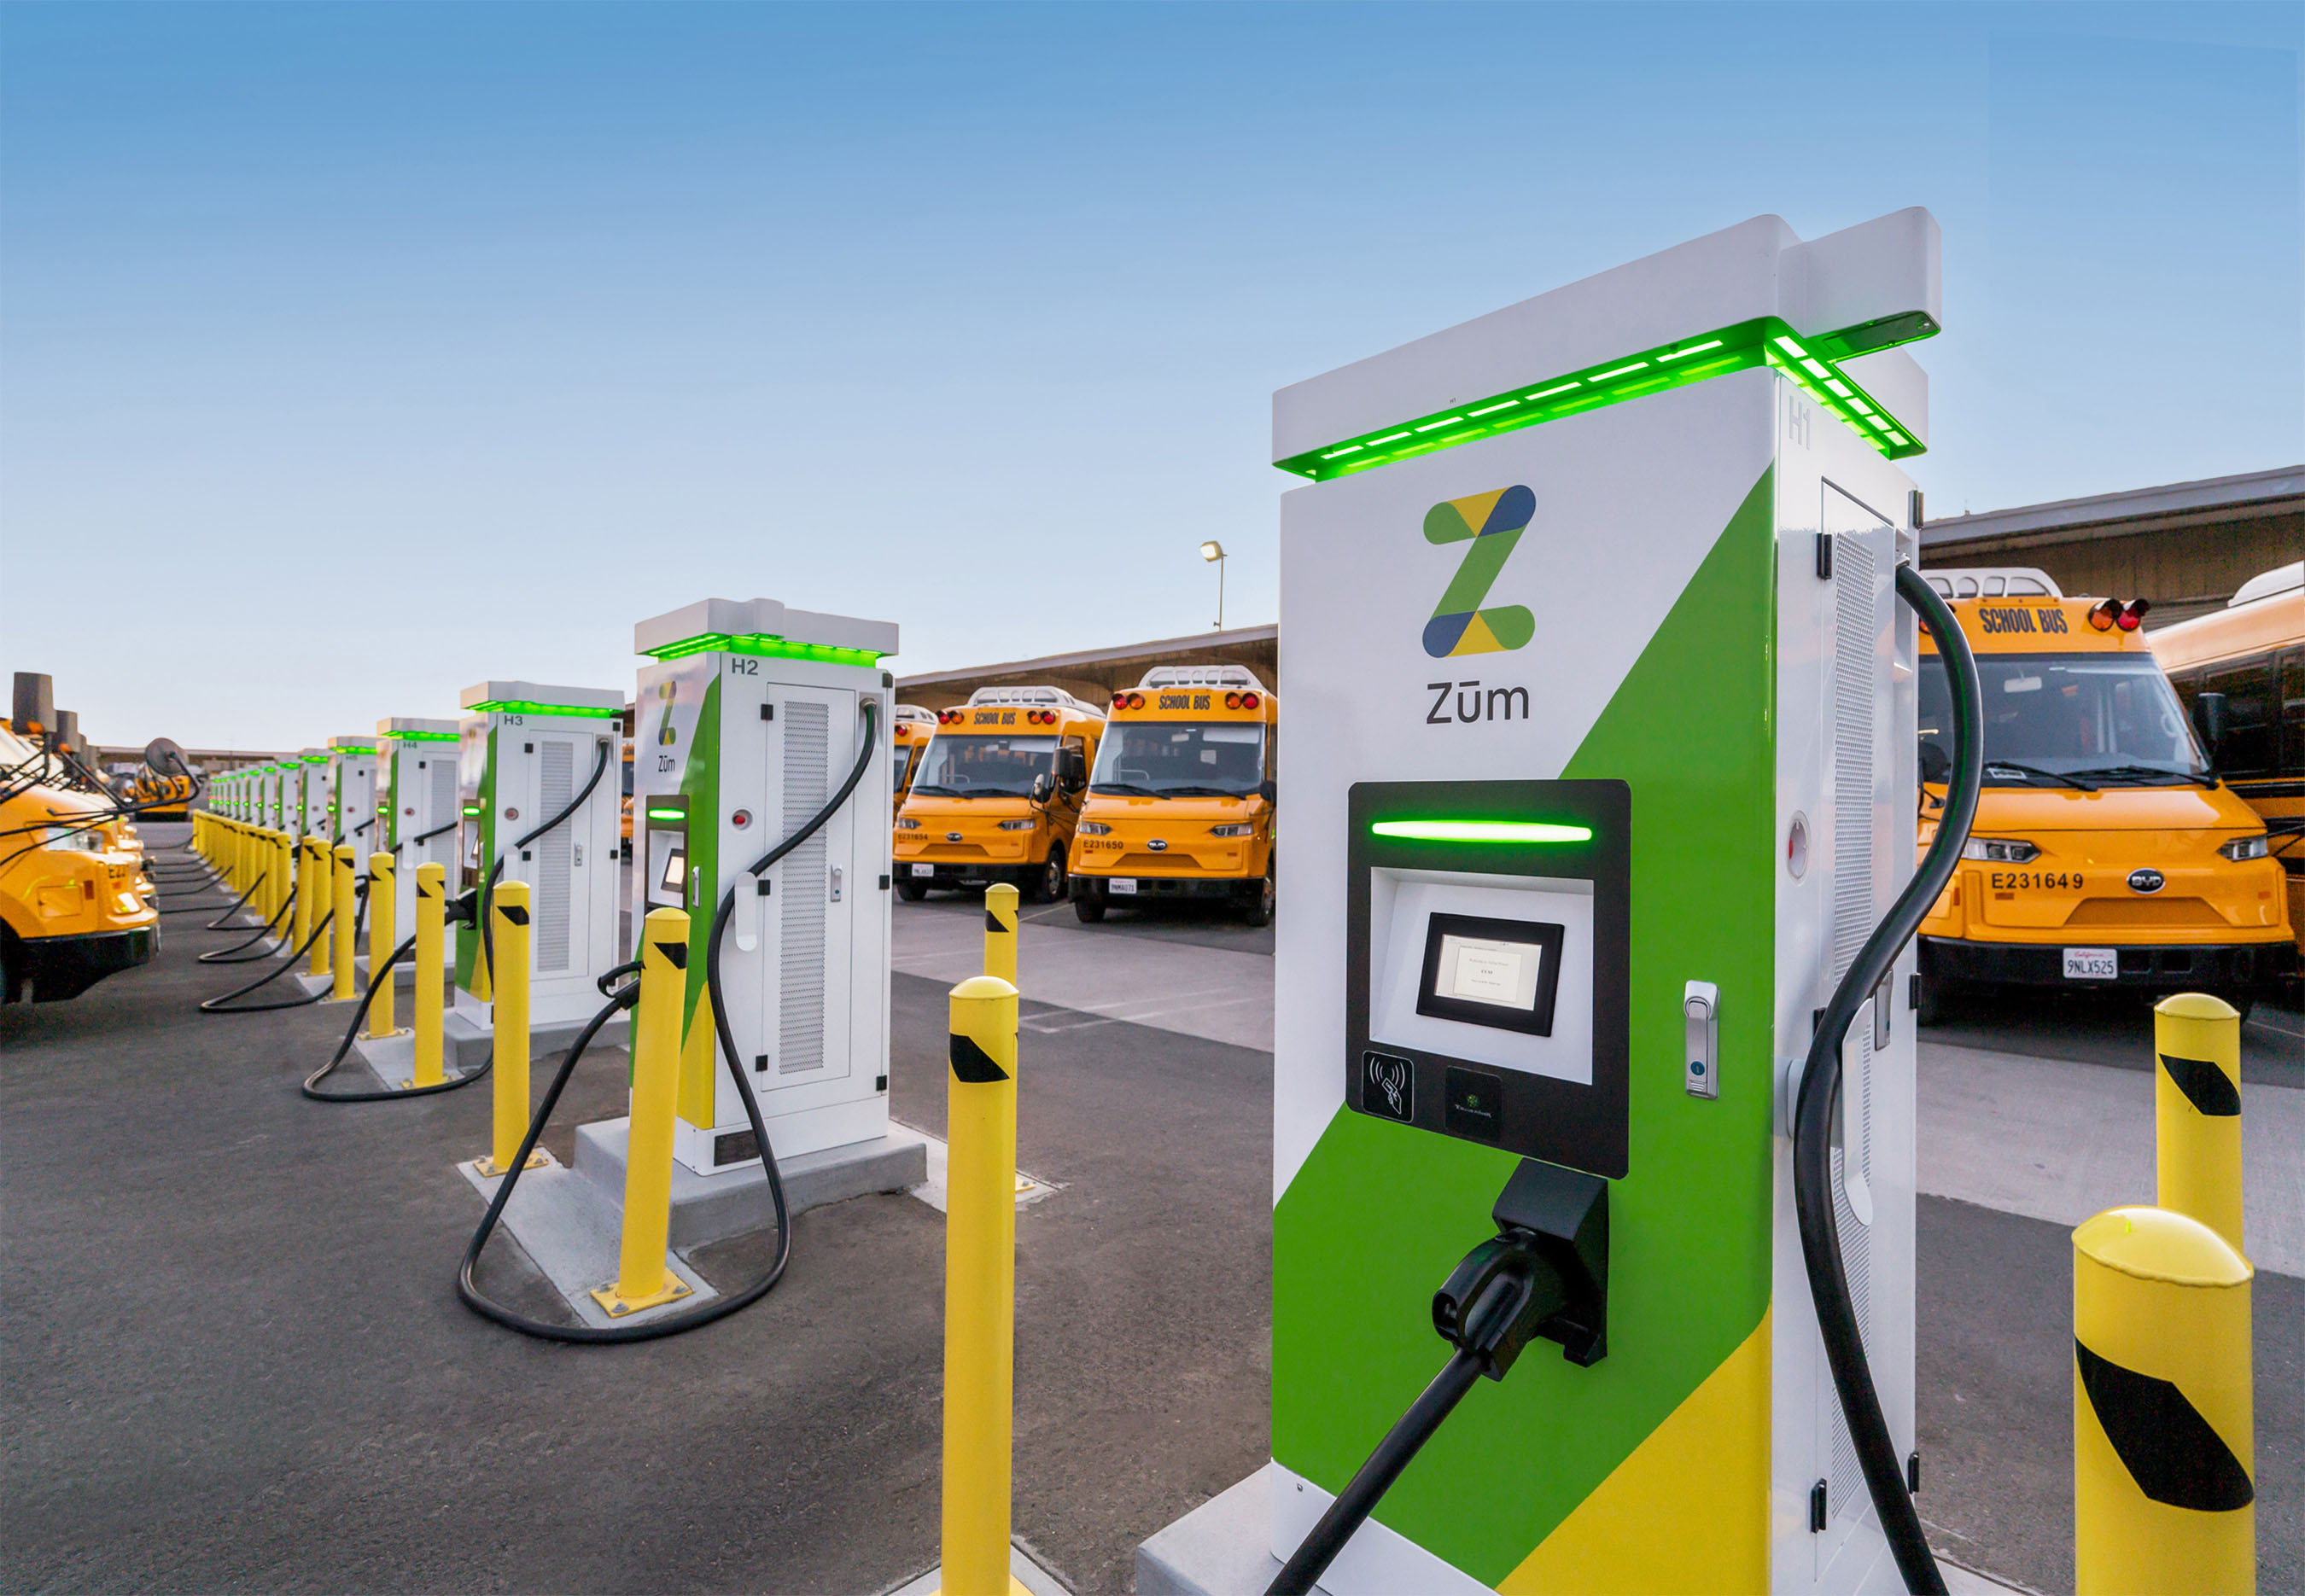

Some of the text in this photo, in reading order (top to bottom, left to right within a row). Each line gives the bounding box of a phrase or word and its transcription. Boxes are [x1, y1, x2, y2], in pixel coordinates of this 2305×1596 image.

[1979, 608, 2069, 633] SCHOOL BUS
[732, 657, 759, 676] H2
[1158, 695, 1211, 710] SCHOOL BUS
[1427, 680, 1529, 725] Zūm
[504, 715, 523, 726] H3
[973, 712, 1016, 725] SCHOOL BUS
[1083, 840, 1123, 849] E231650
[1991, 872, 2084, 889] E231649
[2131, 876, 2162, 887] BYD
[2067, 959, 2115, 975] 9NLX525
